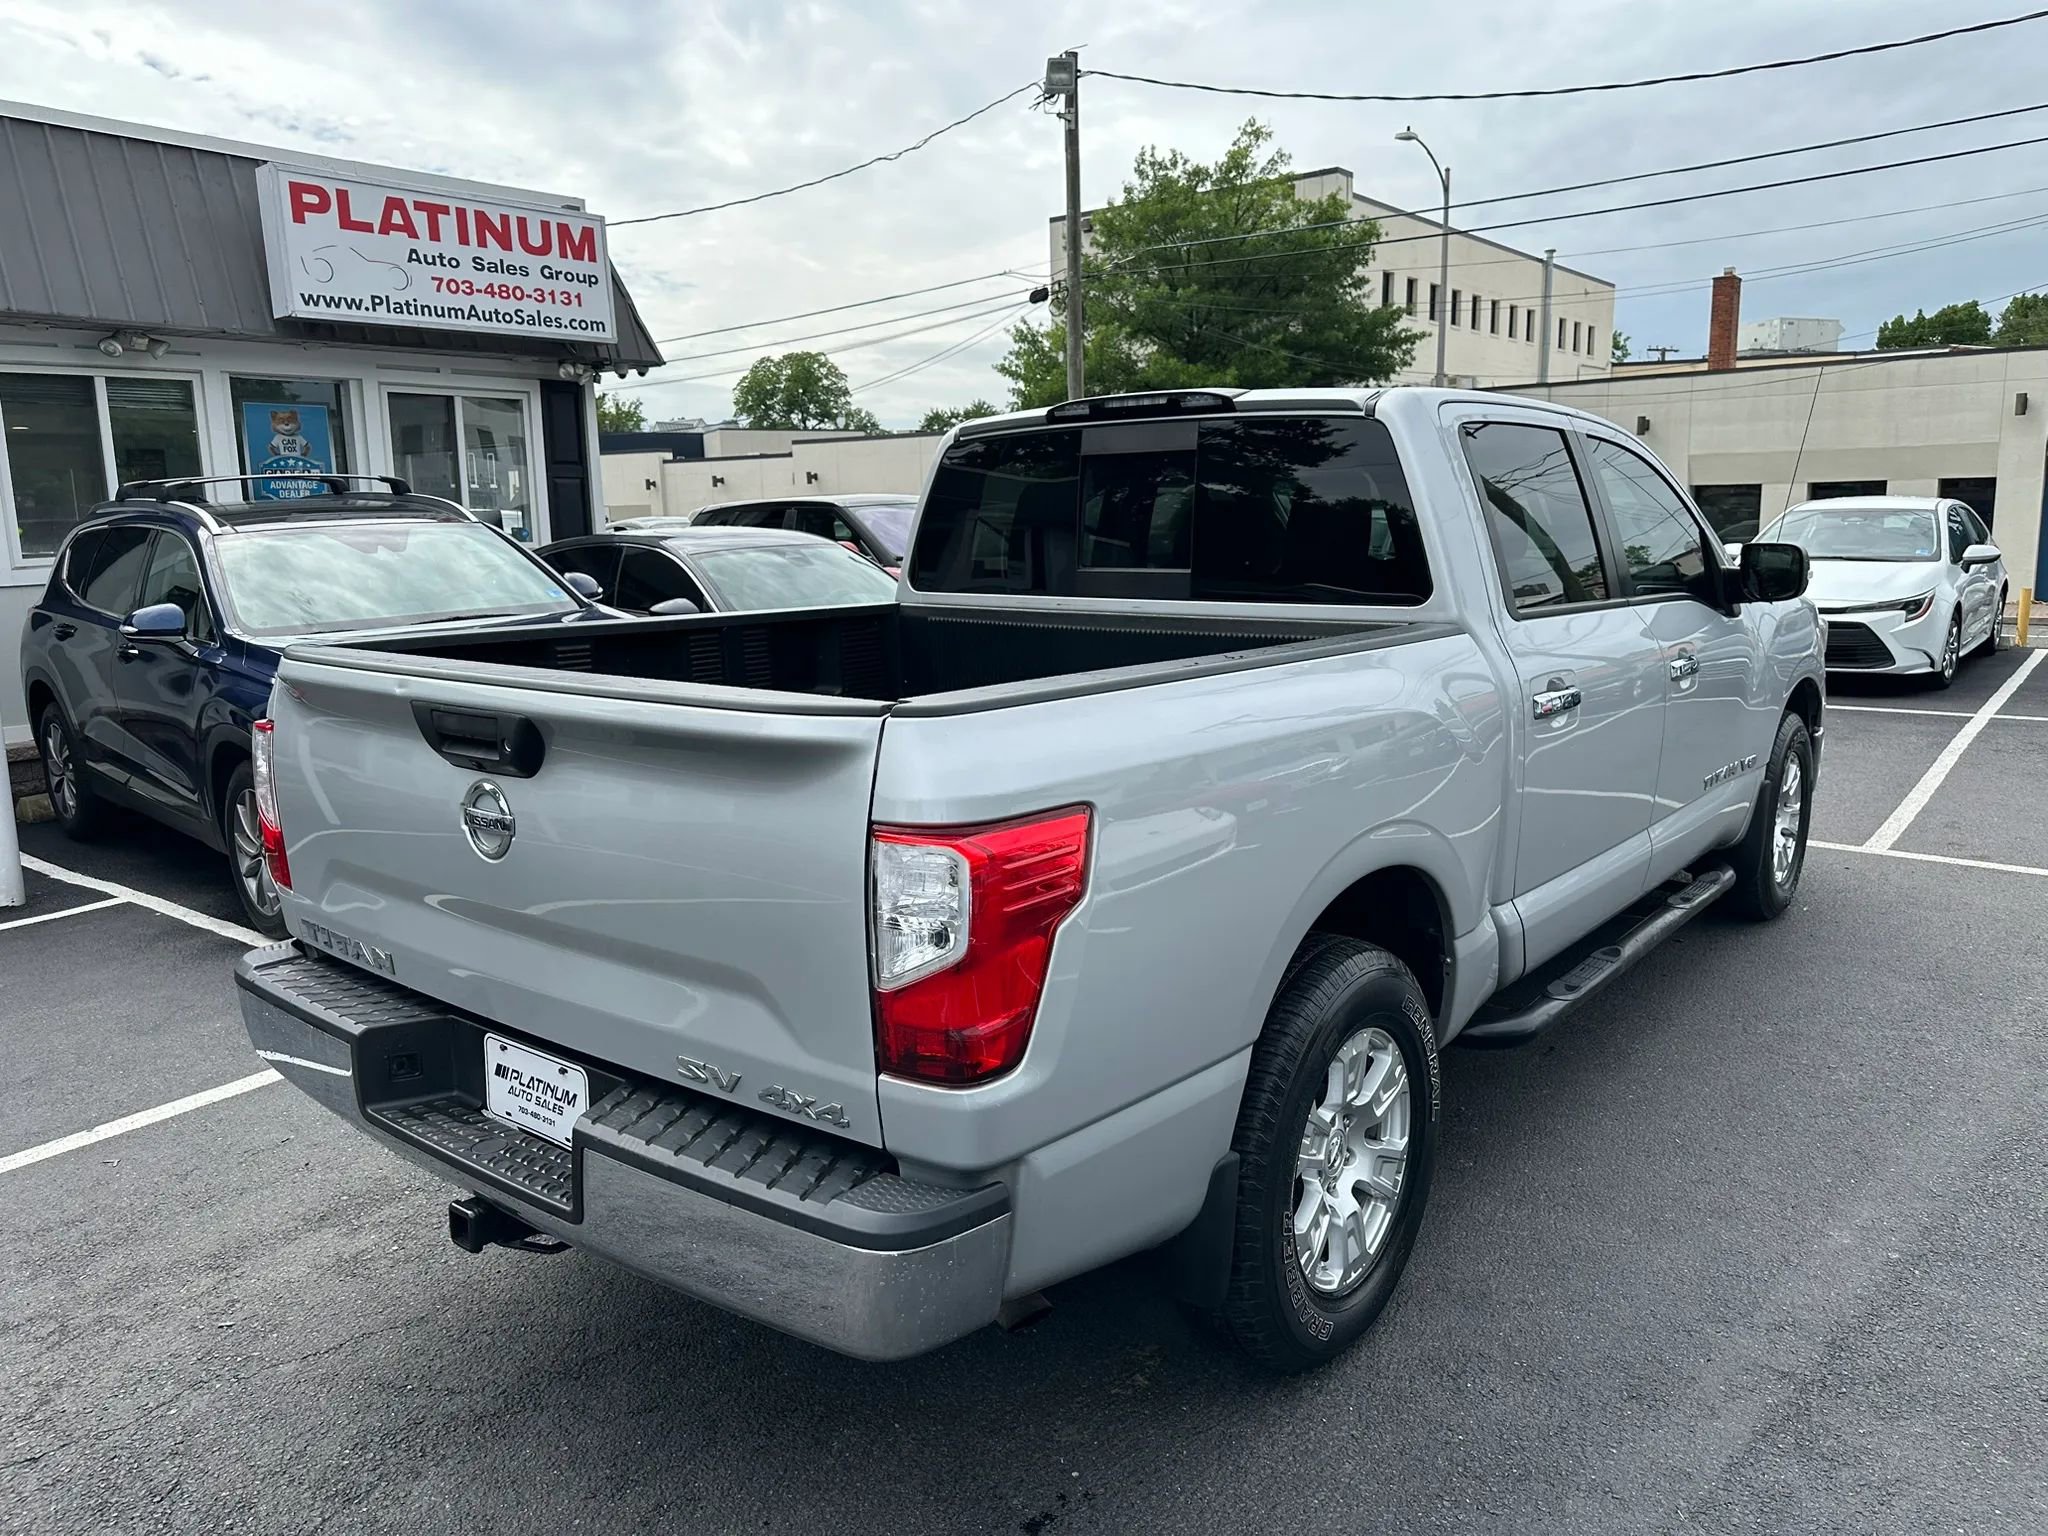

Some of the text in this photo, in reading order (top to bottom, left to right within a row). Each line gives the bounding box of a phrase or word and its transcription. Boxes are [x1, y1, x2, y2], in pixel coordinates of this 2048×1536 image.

[288, 180, 598, 263] PLATINUM
[407, 248, 600, 287] Auto Sales Group
[431, 276, 583, 308] 703-480-3131
[300, 291, 606, 333] www.PlatinumAutoSales.com
[283, 445, 298, 453] FOX
[270, 480, 319, 489] ADVANTAGE
[279, 489, 311, 498] DEALER
[464, 812, 512, 833] NISSAN
[300, 918, 396, 976] TITAN
[676, 1055, 742, 1093] SV
[1402, 993, 1440, 1122] GENERAL
[507, 1085, 565, 1116] AUTO SALES
[509, 1068, 578, 1108] PLATINUM
[518, 1105, 556, 1127] 703-480-3131
